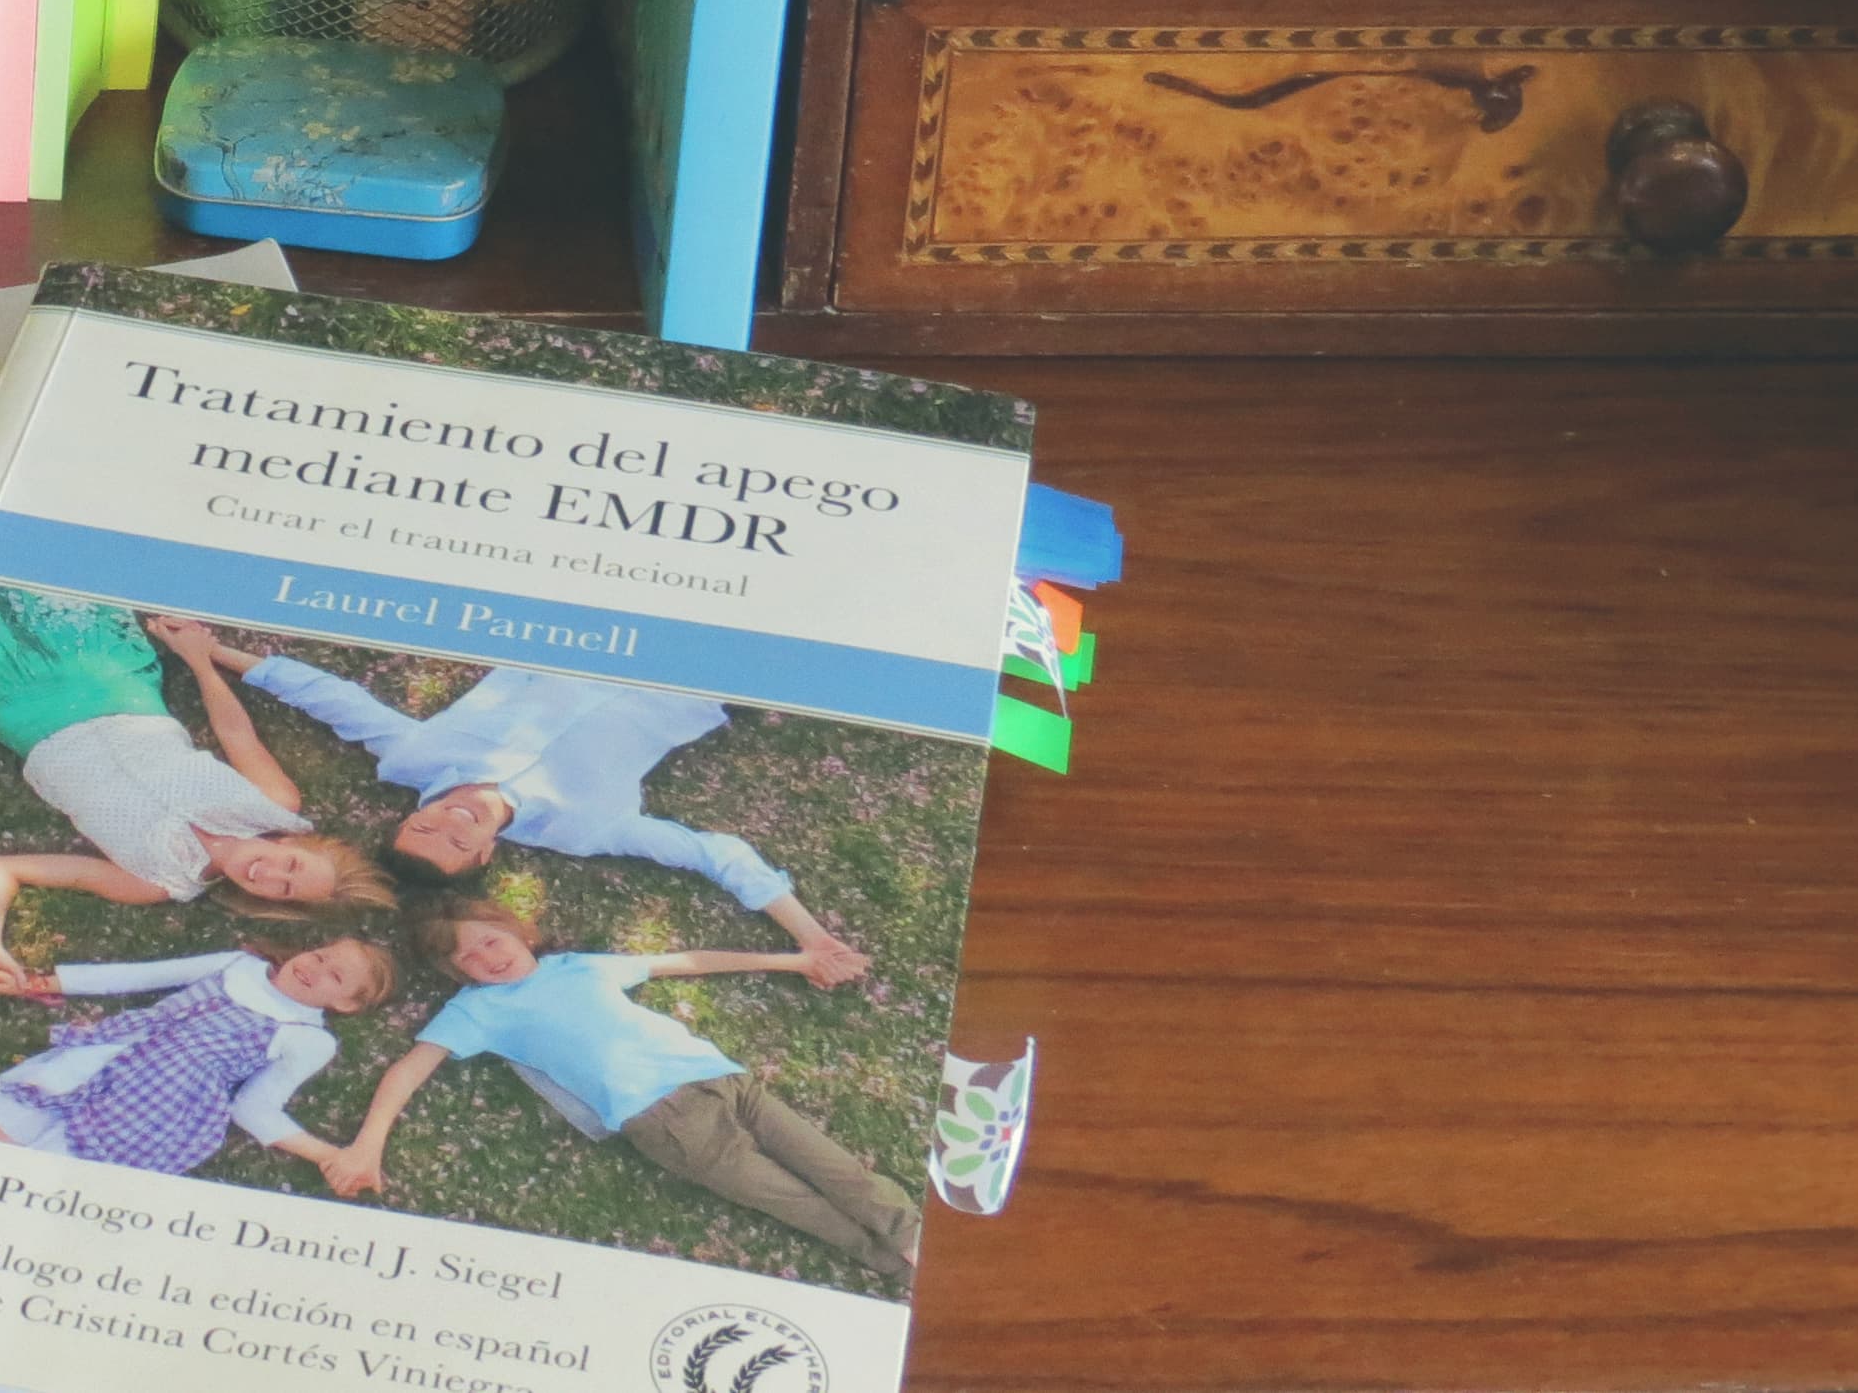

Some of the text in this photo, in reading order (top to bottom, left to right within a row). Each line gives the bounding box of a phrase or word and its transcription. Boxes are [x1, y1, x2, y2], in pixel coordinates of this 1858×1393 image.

[126, 360, 900, 517] Tratamiento del apego
[189, 440, 795, 557] mediante EMDR
[206, 493, 749, 597] Curar el trauma relacional
[272, 573, 639, 658] Laurel Parnell
[167, 1210, 216, 1242] de
[230, 1219, 375, 1268] Daniel
[378, 1245, 416, 1281] J.
[434, 1253, 563, 1301] Siegel
[20, 1293, 185, 1348] Cristina
[202, 1326, 338, 1372] Cortés
[97, 1265, 143, 1297] de
[158, 1275, 193, 1306] la
[209, 1289, 355, 1333] edición
[370, 1316, 417, 1342] en
[434, 1327, 590, 1372] español
[657, 1308, 736, 1380] EDITORIAL
